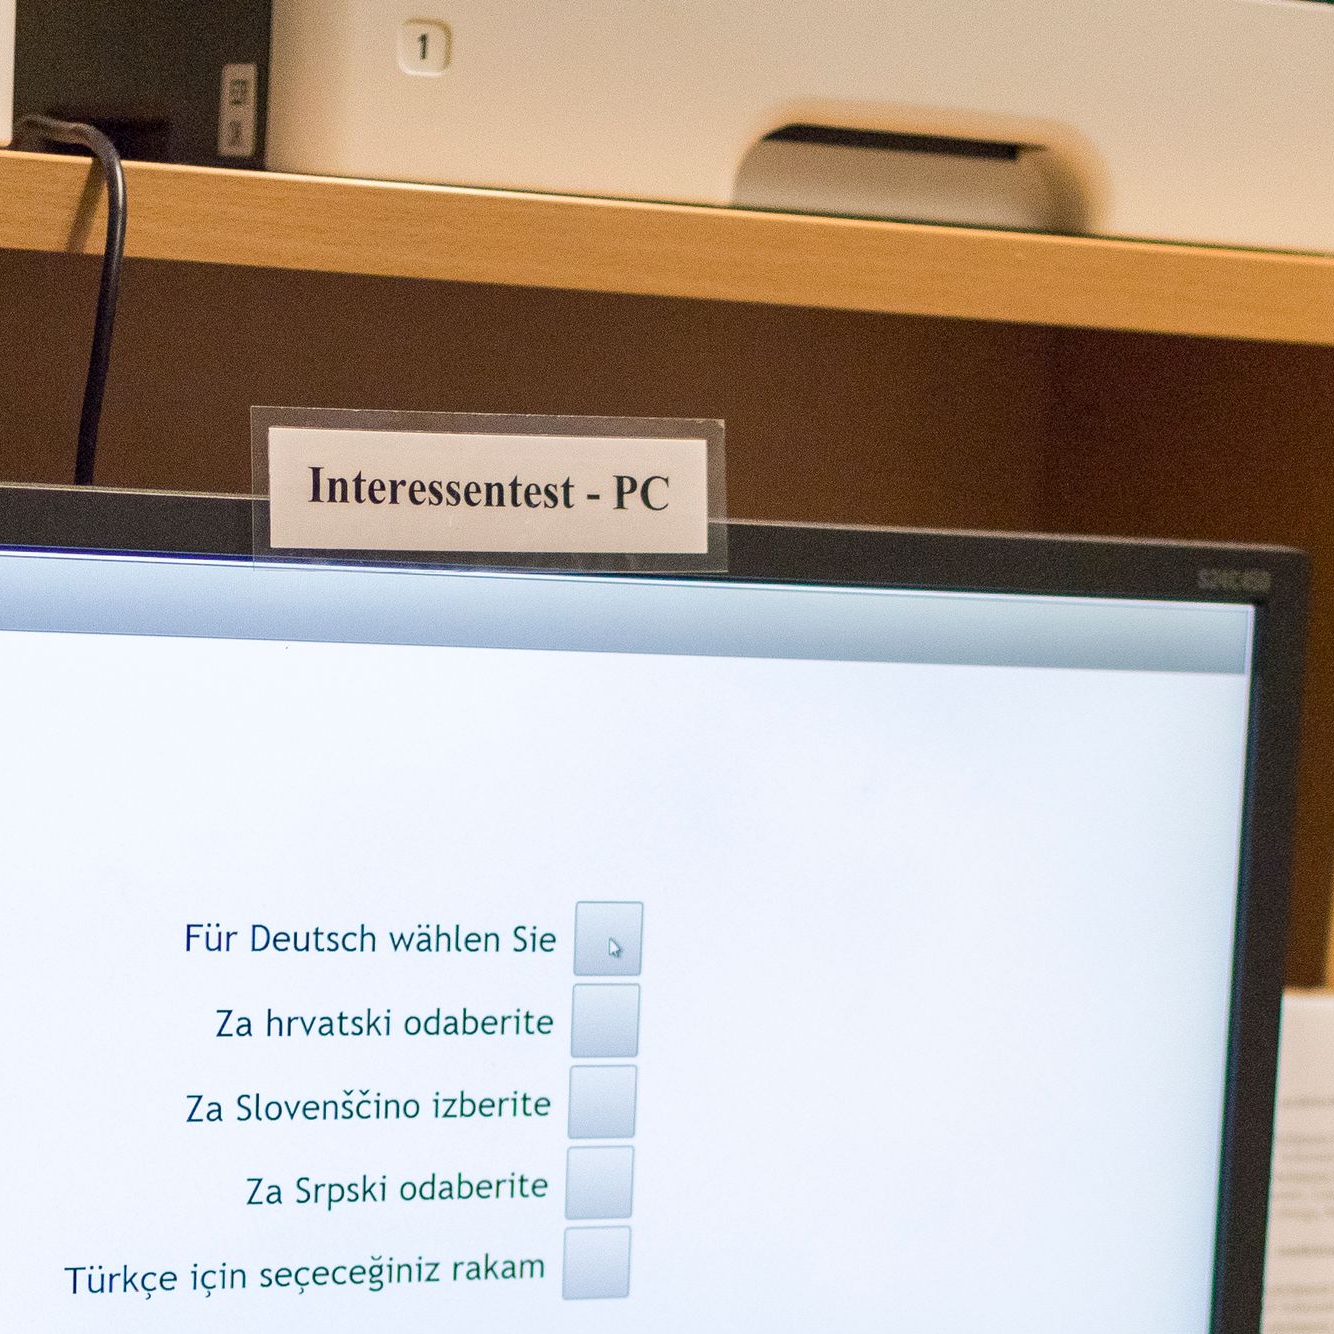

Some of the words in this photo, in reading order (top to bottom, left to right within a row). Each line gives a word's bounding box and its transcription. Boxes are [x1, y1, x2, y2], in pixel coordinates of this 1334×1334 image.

[416, 34, 430, 61] 1
[307, 465, 575, 510] Interessentest
[612, 474, 671, 511] PC
[184, 923, 238, 953] Für
[251, 924, 377, 953] Deutsch
[389, 925, 501, 953] wählen
[513, 925, 557, 953] Sie
[215, 1009, 253, 1038] Za
[267, 1009, 392, 1037] hrvatski
[404, 1007, 554, 1036] odaberite
[186, 1094, 223, 1123] Za
[236, 1088, 420, 1122] Slovenščino
[433, 1090, 551, 1119] izberite
[246, 1176, 283, 1205] Za
[296, 1175, 387, 1211] Srpski
[400, 1173, 548, 1202] odaberite
[65, 1264, 178, 1301] Türkçe
[190, 1263, 247, 1298] için
[259, 1253, 441, 1294] seçeceğiniz
[452, 1253, 546, 1282] rakam
